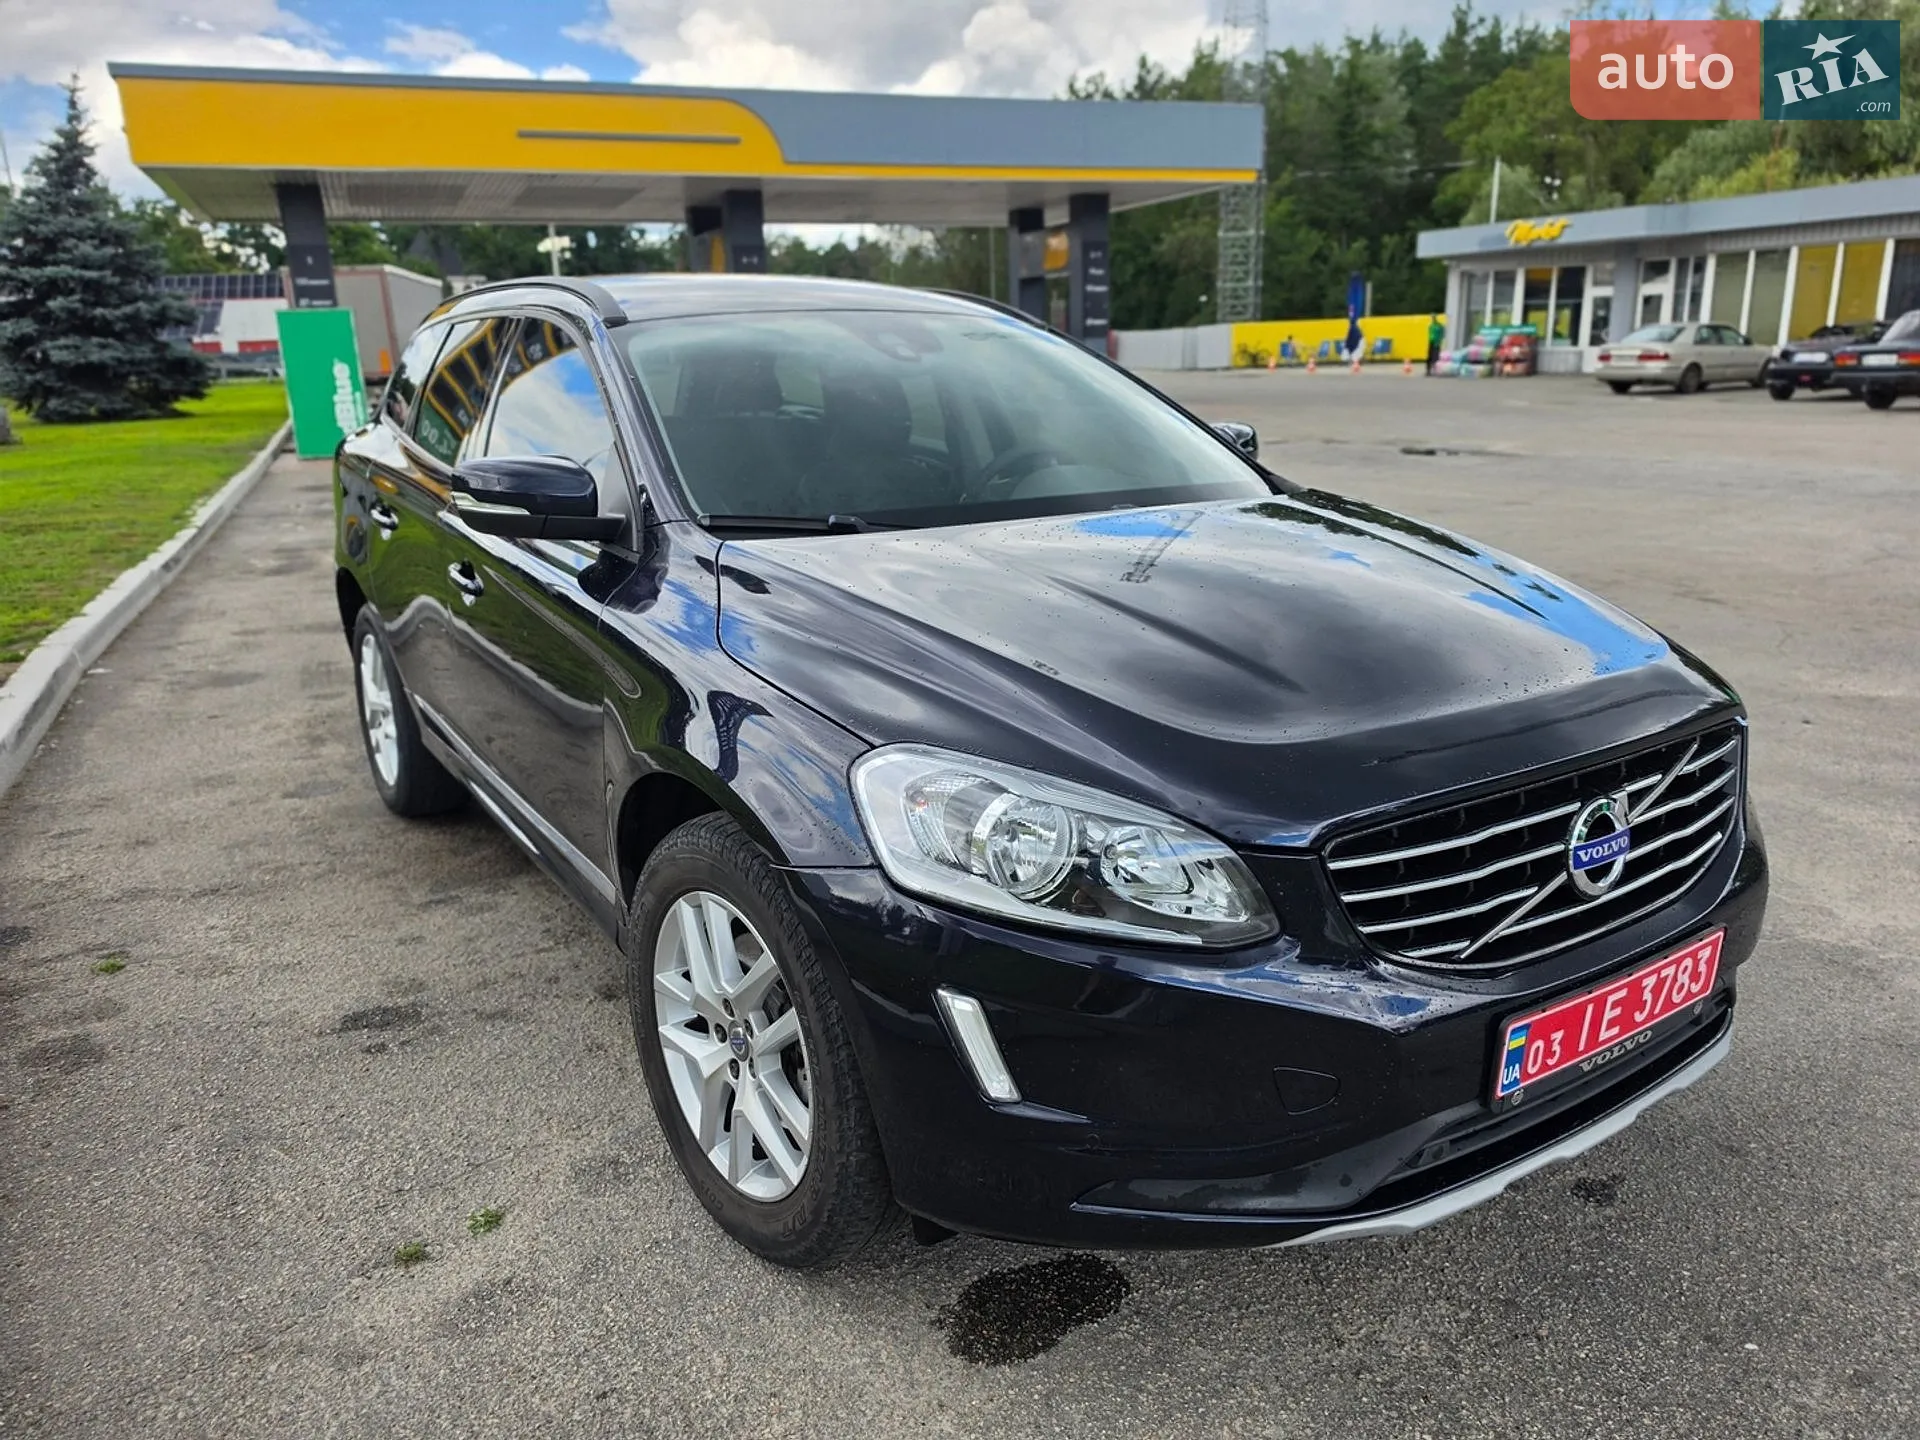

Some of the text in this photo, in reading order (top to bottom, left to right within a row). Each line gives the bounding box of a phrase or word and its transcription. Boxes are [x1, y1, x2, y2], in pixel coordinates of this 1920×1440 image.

[1577, 836, 1628, 863] VOLVO
[1526, 945, 1713, 1075] 03 IE 3783
[1579, 1030, 1653, 1072] VOLVO
[1503, 1066, 1520, 1085] UA
